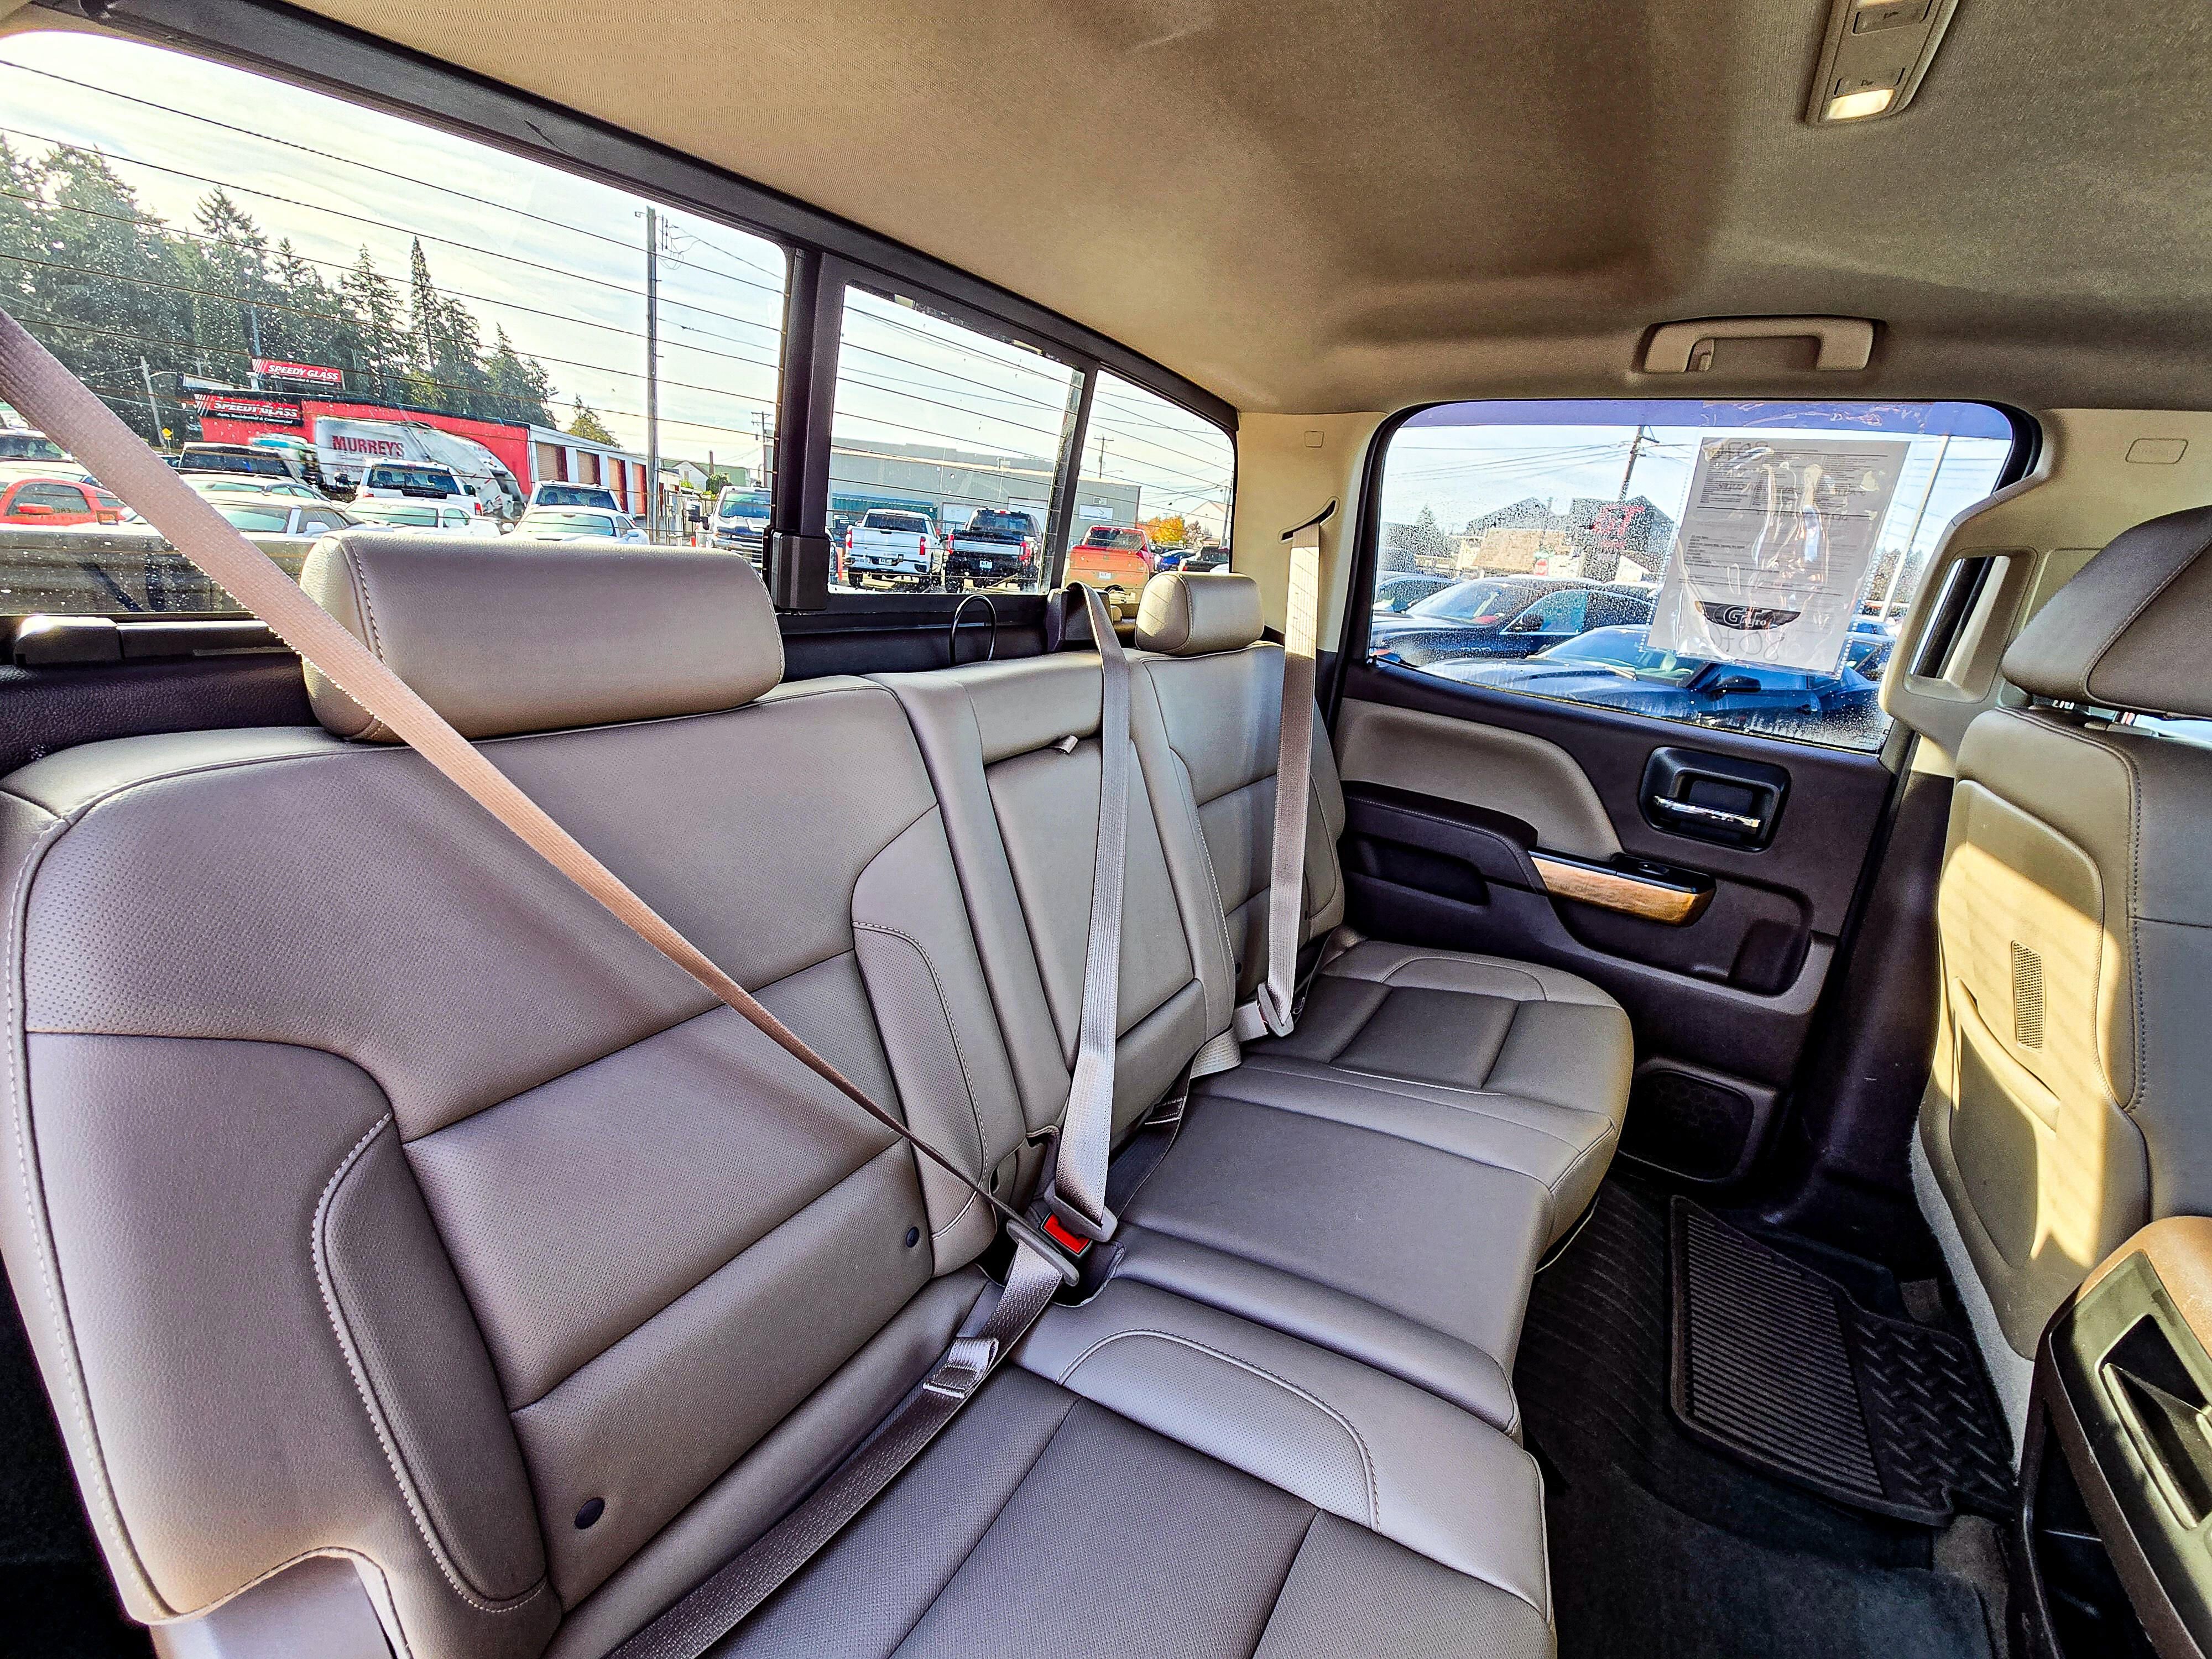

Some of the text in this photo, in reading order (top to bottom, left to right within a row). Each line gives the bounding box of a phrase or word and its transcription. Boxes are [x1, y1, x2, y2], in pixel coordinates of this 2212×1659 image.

[268, 364, 338, 380] SPEEDY GLASS
[214, 400, 298, 417] SPEEDY GLASS
